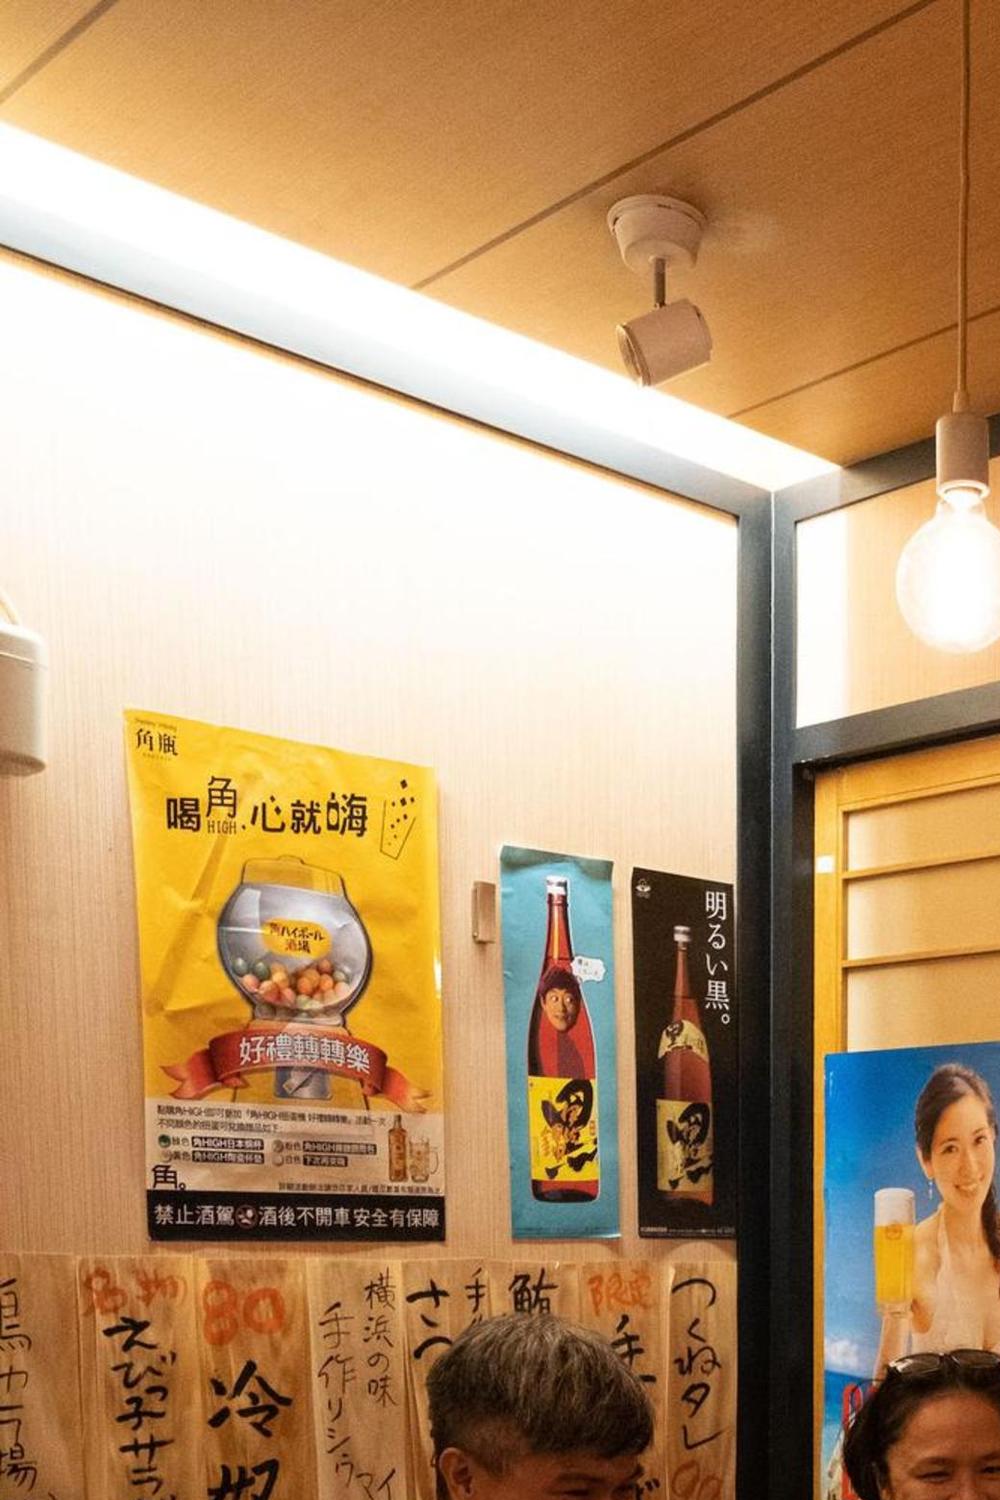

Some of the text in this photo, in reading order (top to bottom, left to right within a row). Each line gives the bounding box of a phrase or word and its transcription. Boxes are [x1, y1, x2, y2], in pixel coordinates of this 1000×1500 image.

[239, 1035, 371, 1075] 好禮轉轉樂
[154, 1205, 440, 1229] 禁止酒駕 酒後不開車 安全有保障
[363, 1267, 397, 1408] 横浜の味
